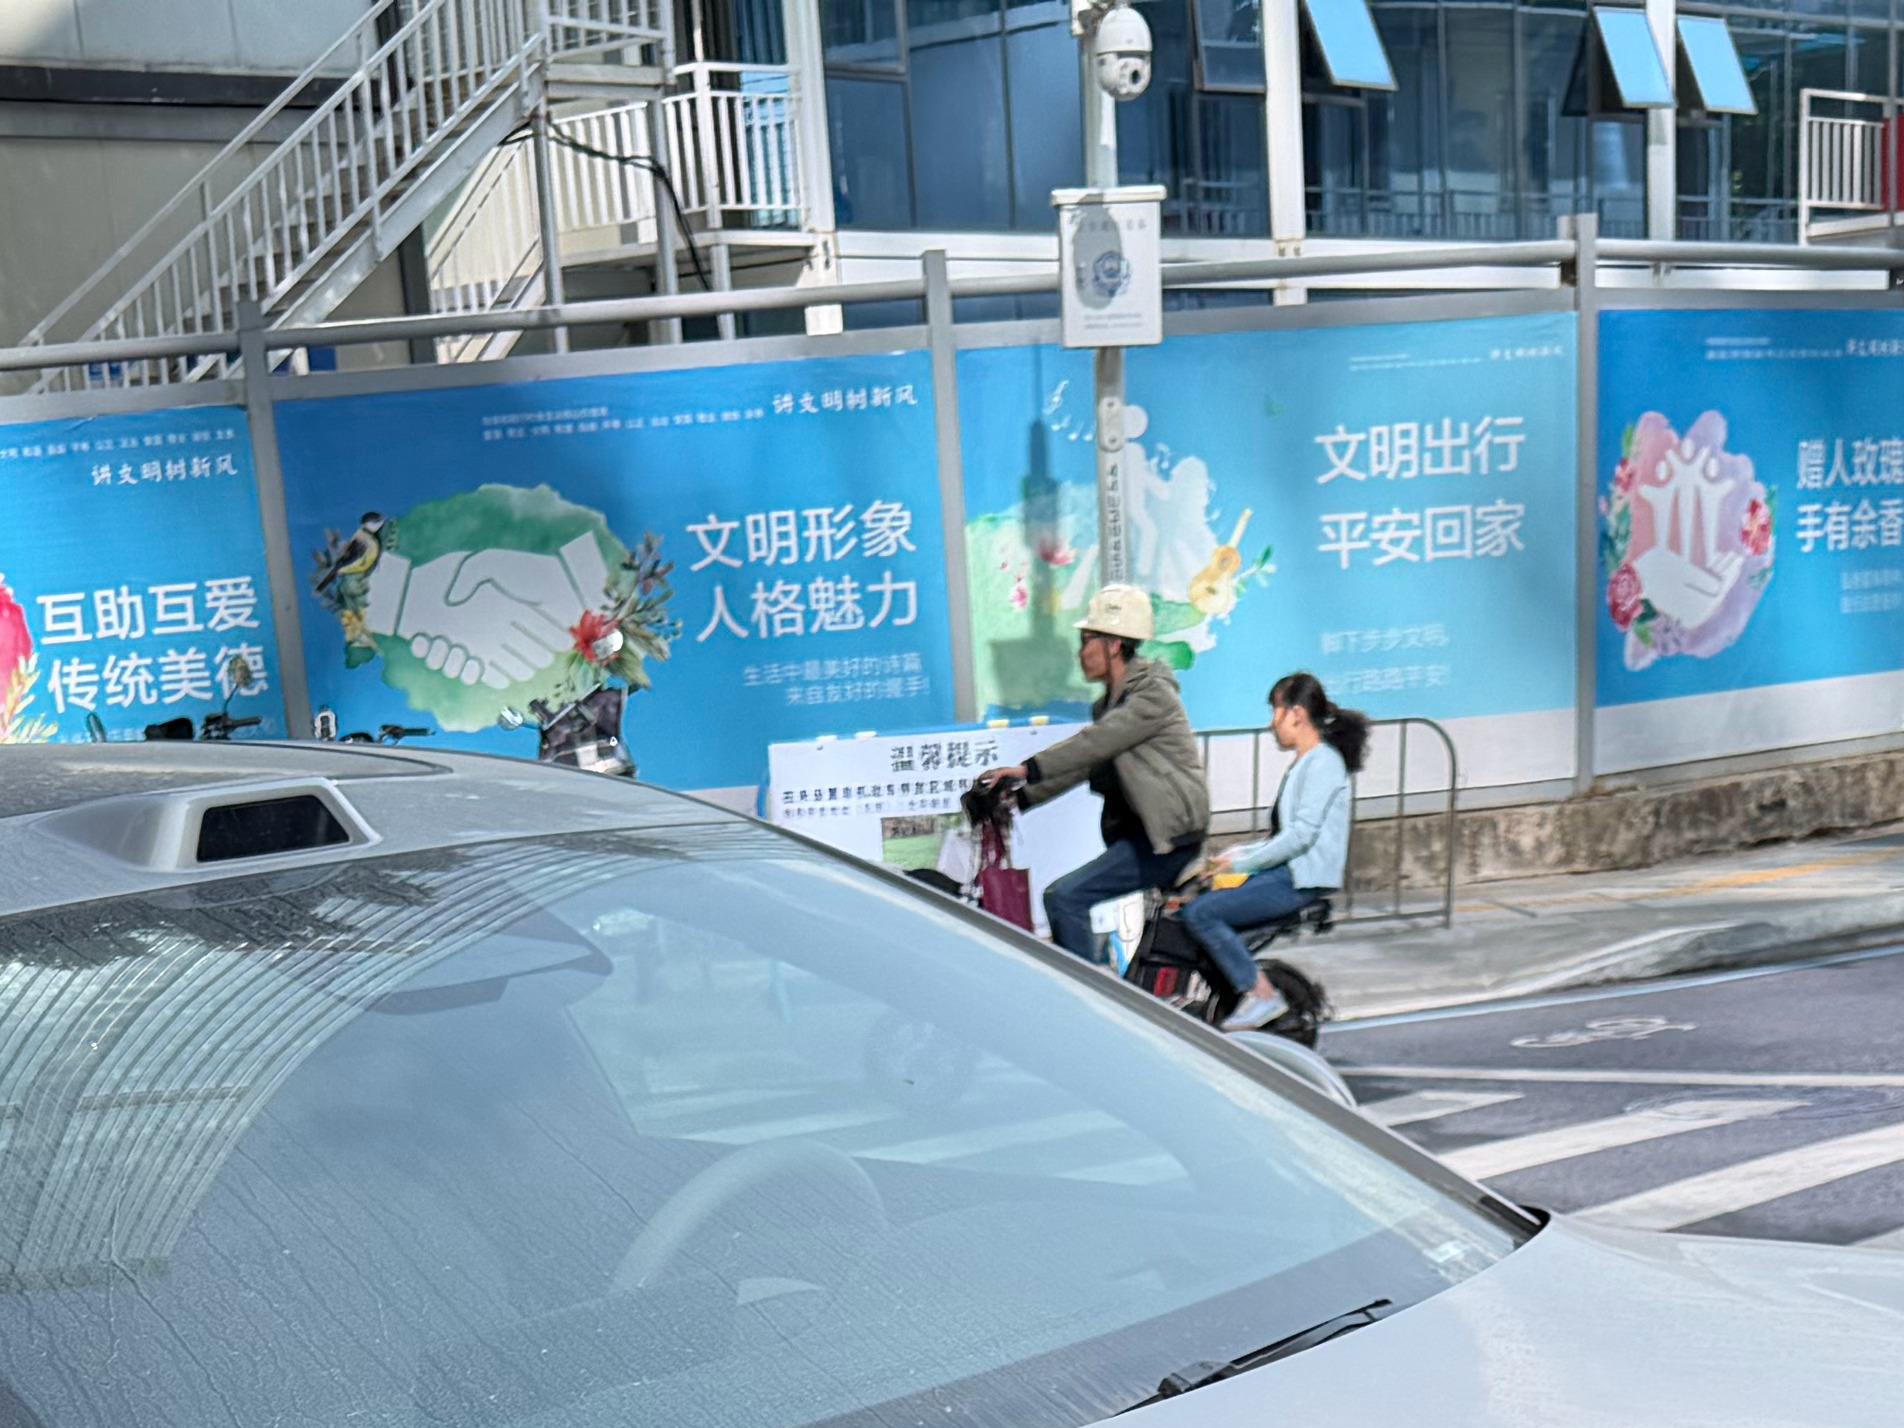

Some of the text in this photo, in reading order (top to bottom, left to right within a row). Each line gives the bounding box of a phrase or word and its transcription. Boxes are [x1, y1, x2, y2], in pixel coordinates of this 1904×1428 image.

[91, 453, 239, 487] 讲文明树新风
[1314, 416, 1526, 484] 文明出行
[685, 499, 918, 572] 文明形象
[1317, 498, 1526, 571] 平安回家
[35, 575, 261, 646] 互助互爱
[695, 569, 919, 643] 人格魅力
[47, 641, 269, 715] 传统美德
